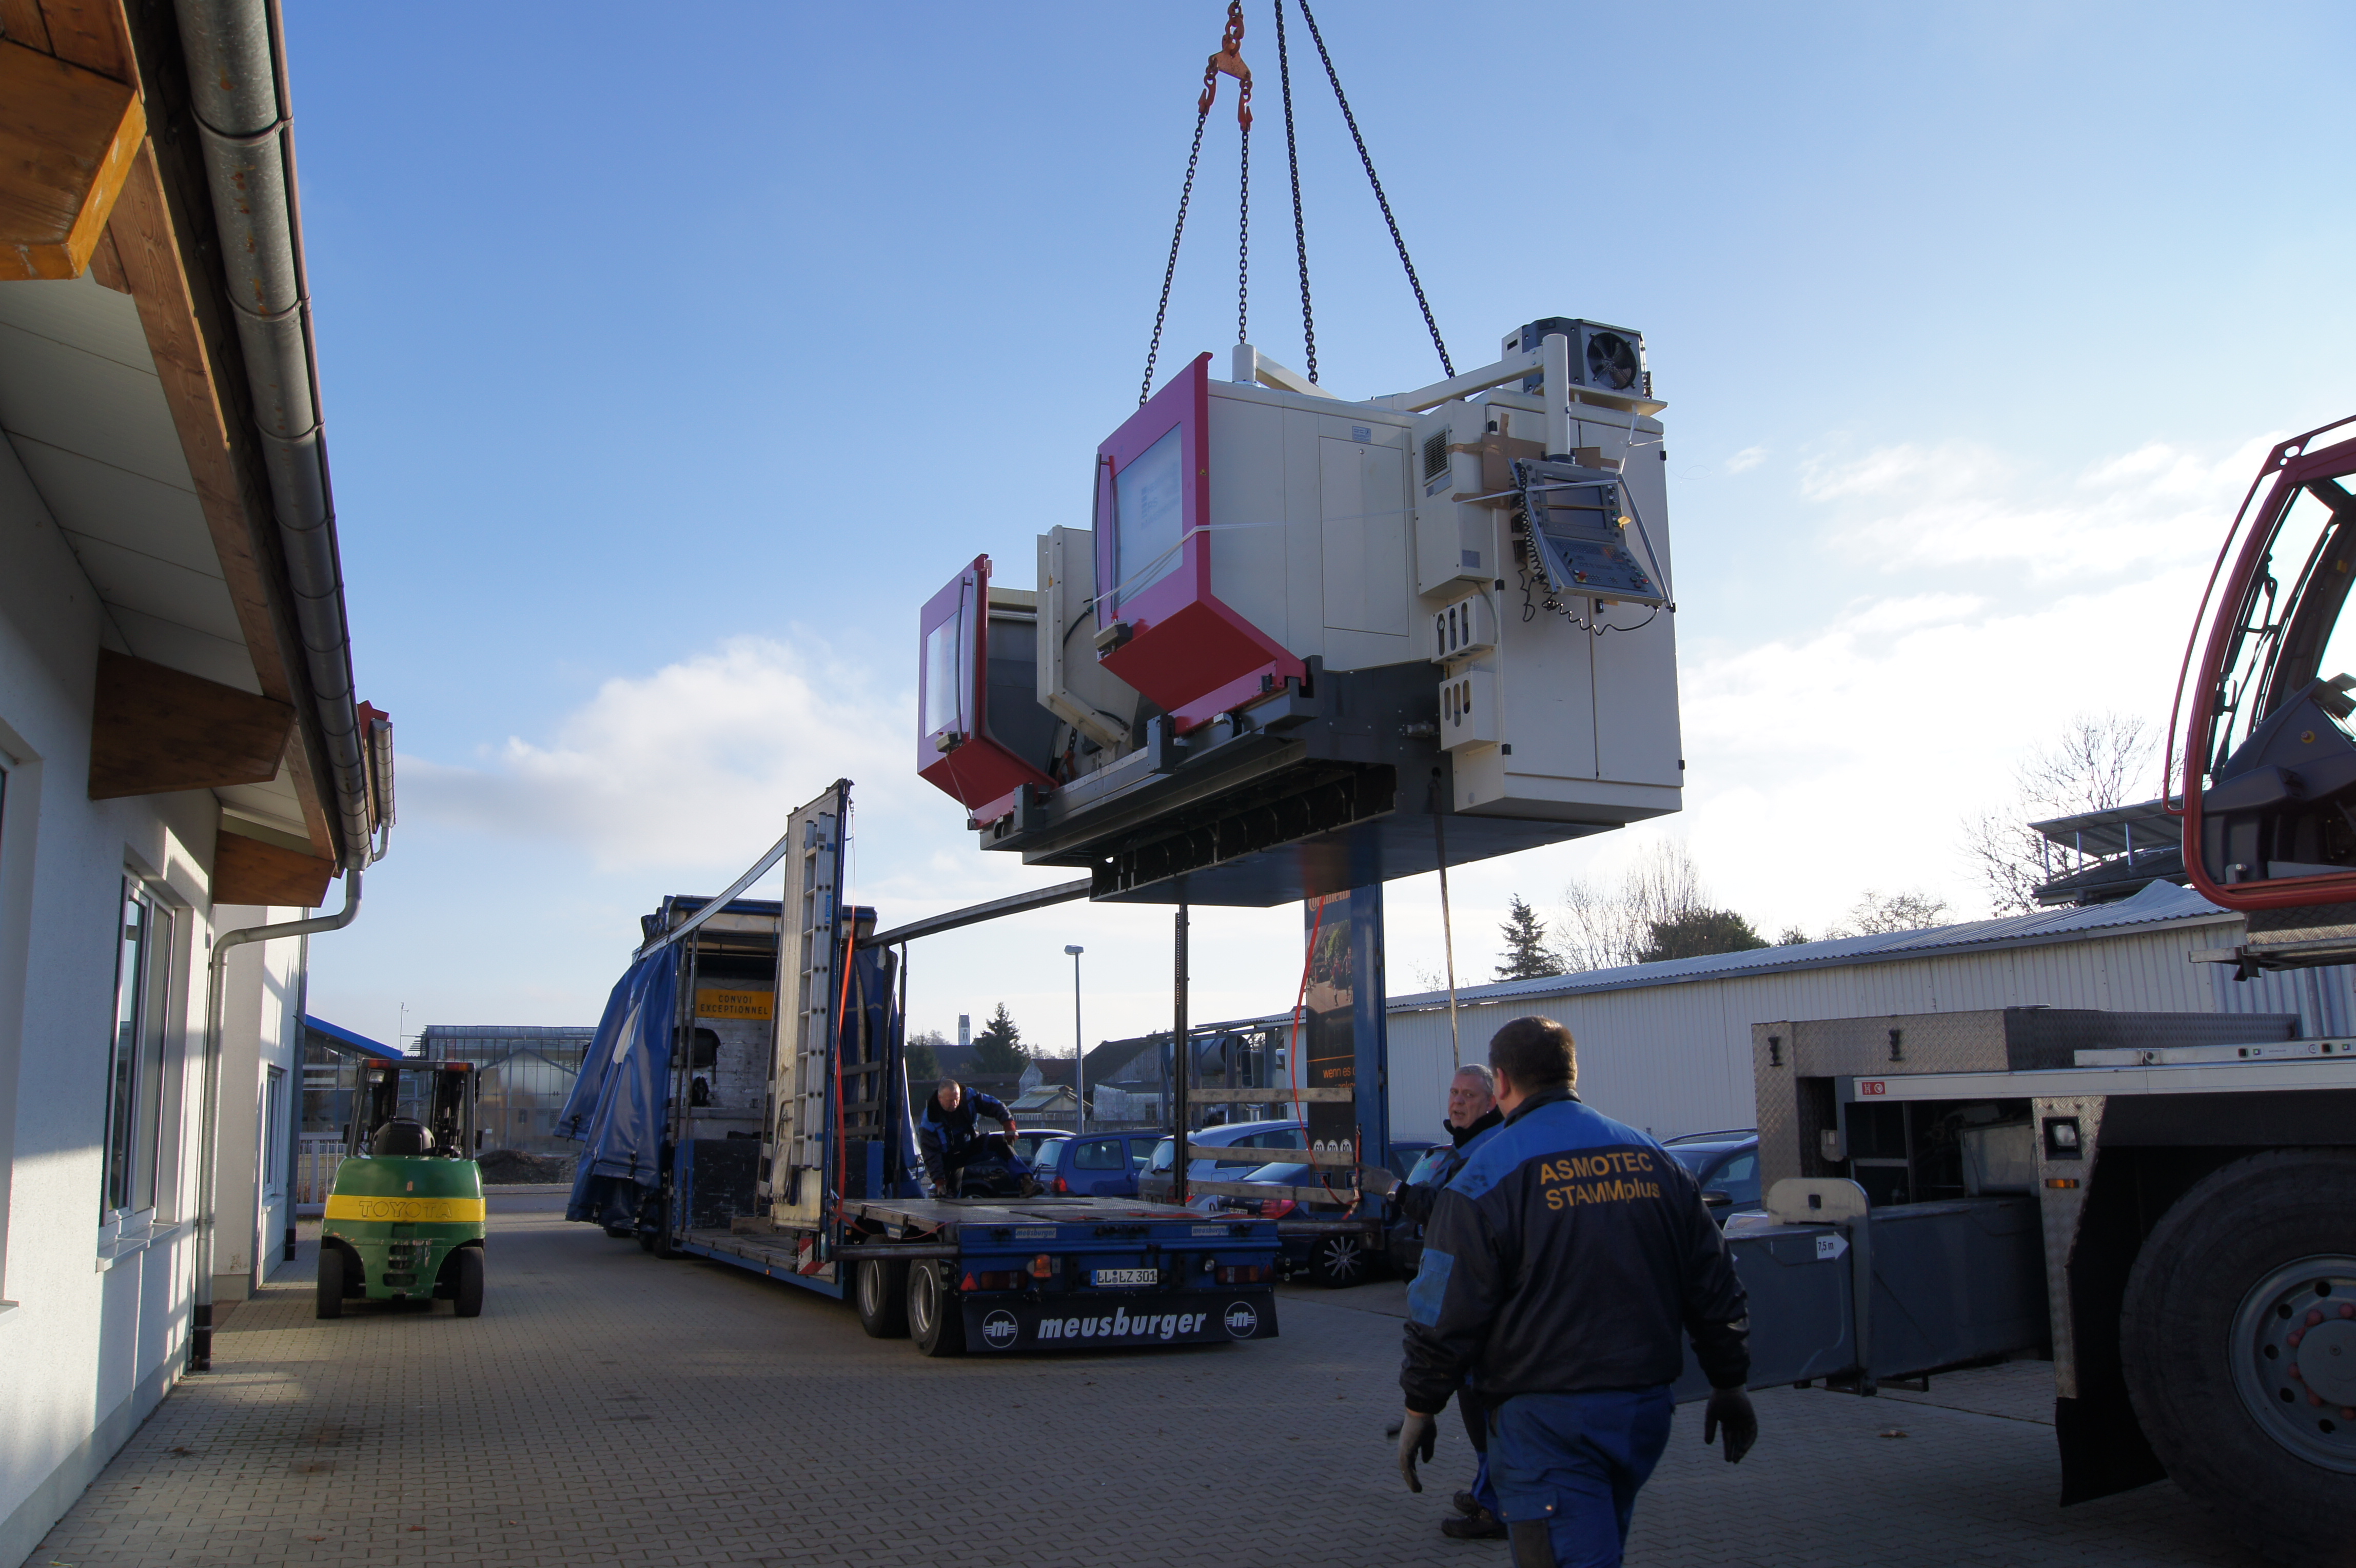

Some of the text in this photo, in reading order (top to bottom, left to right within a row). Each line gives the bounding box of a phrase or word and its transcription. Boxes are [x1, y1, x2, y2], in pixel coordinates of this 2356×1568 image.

[719, 995, 752, 1004] CONVOI
[700, 1004, 768, 1014] EXCEPTIONNEL
[1323, 1068, 1341, 1078] wenn
[1343, 1067, 1351, 1076] es
[1540, 1152, 1653, 1185] ASMOTEC
[1545, 1178, 1660, 1210] STAMMplus
[359, 1201, 451, 1219] TOYOTA
[1016, 1228, 1055, 1238] meusburger
[1818, 1241, 1834, 1252] 7,5 m
[1097, 1270, 1156, 1283] LL LZ 301
[1038, 1307, 1207, 1340] meusburger
